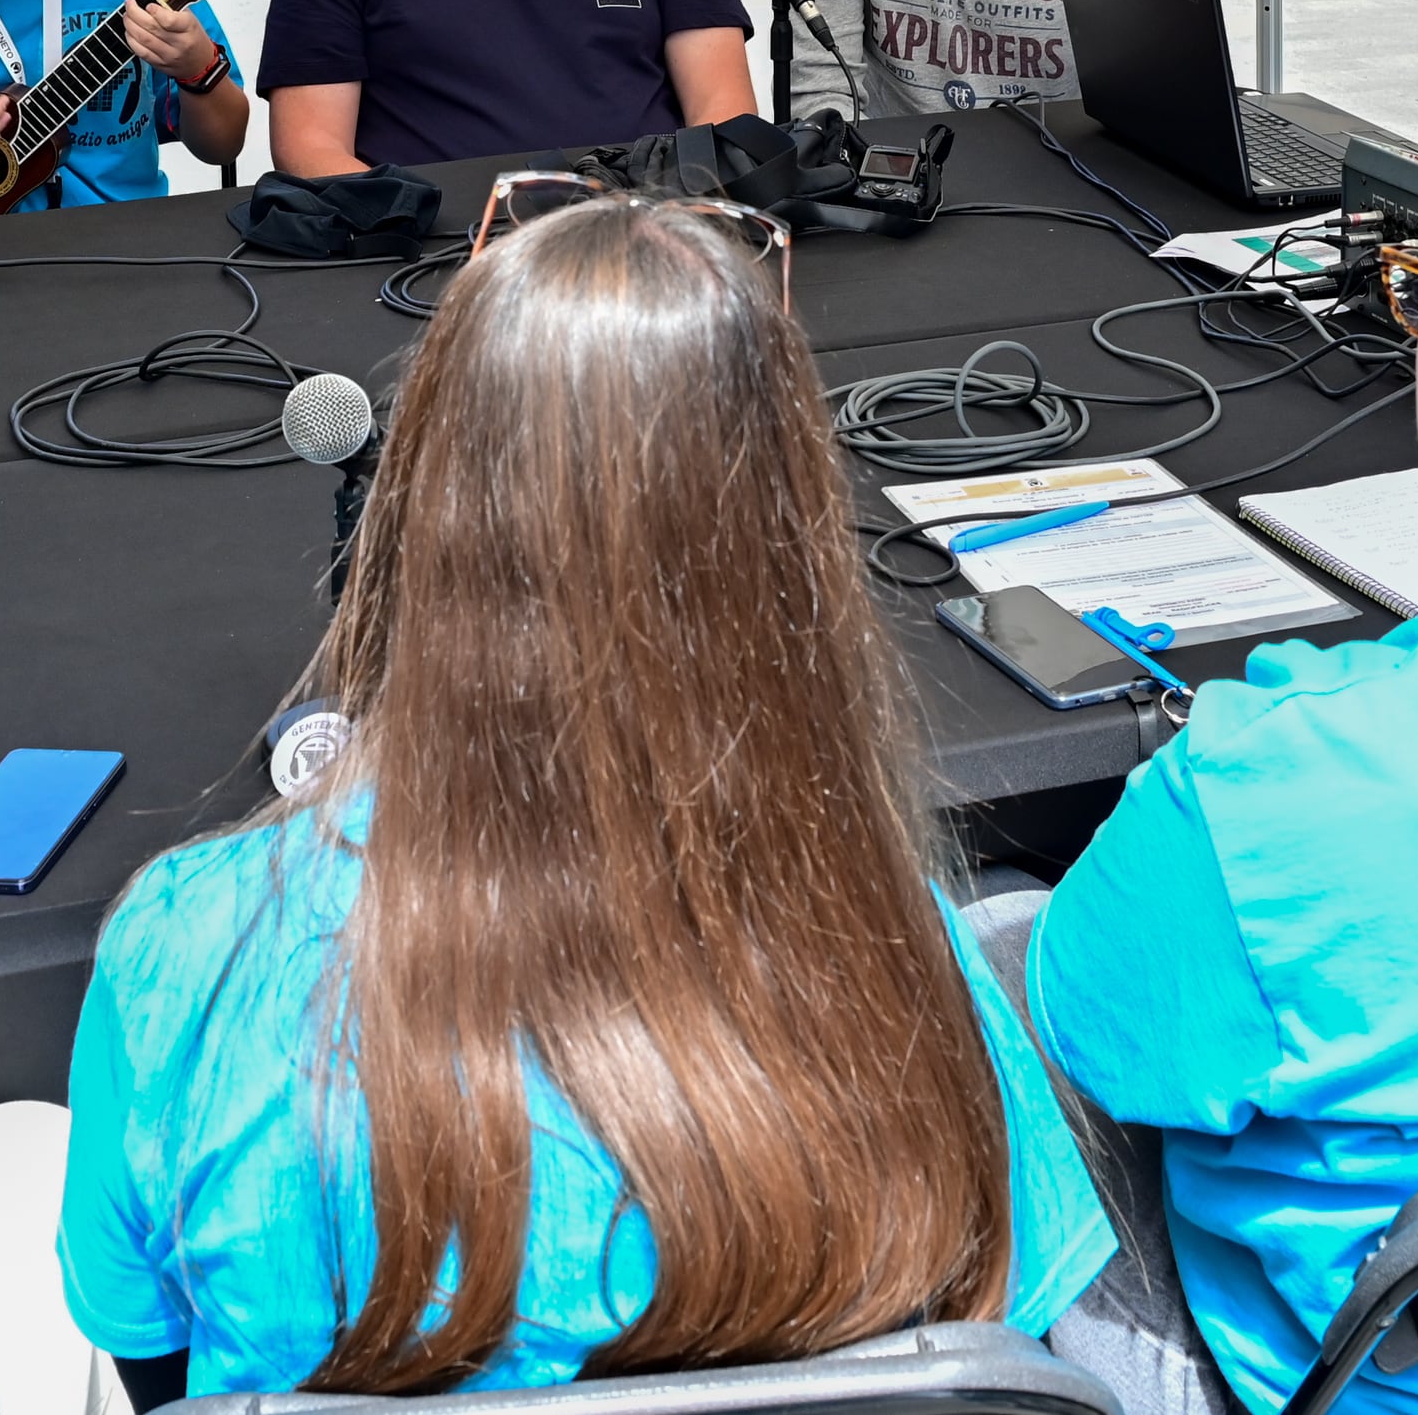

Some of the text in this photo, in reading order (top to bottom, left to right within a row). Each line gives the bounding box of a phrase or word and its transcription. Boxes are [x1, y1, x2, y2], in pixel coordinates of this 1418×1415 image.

[930, 6, 993, 29] MADE FOR
[974, 0, 1056, 22] OUTFITS
[870, 5, 1066, 80] EXPLORERS
[69, 113, 150, 147] adio amiga
